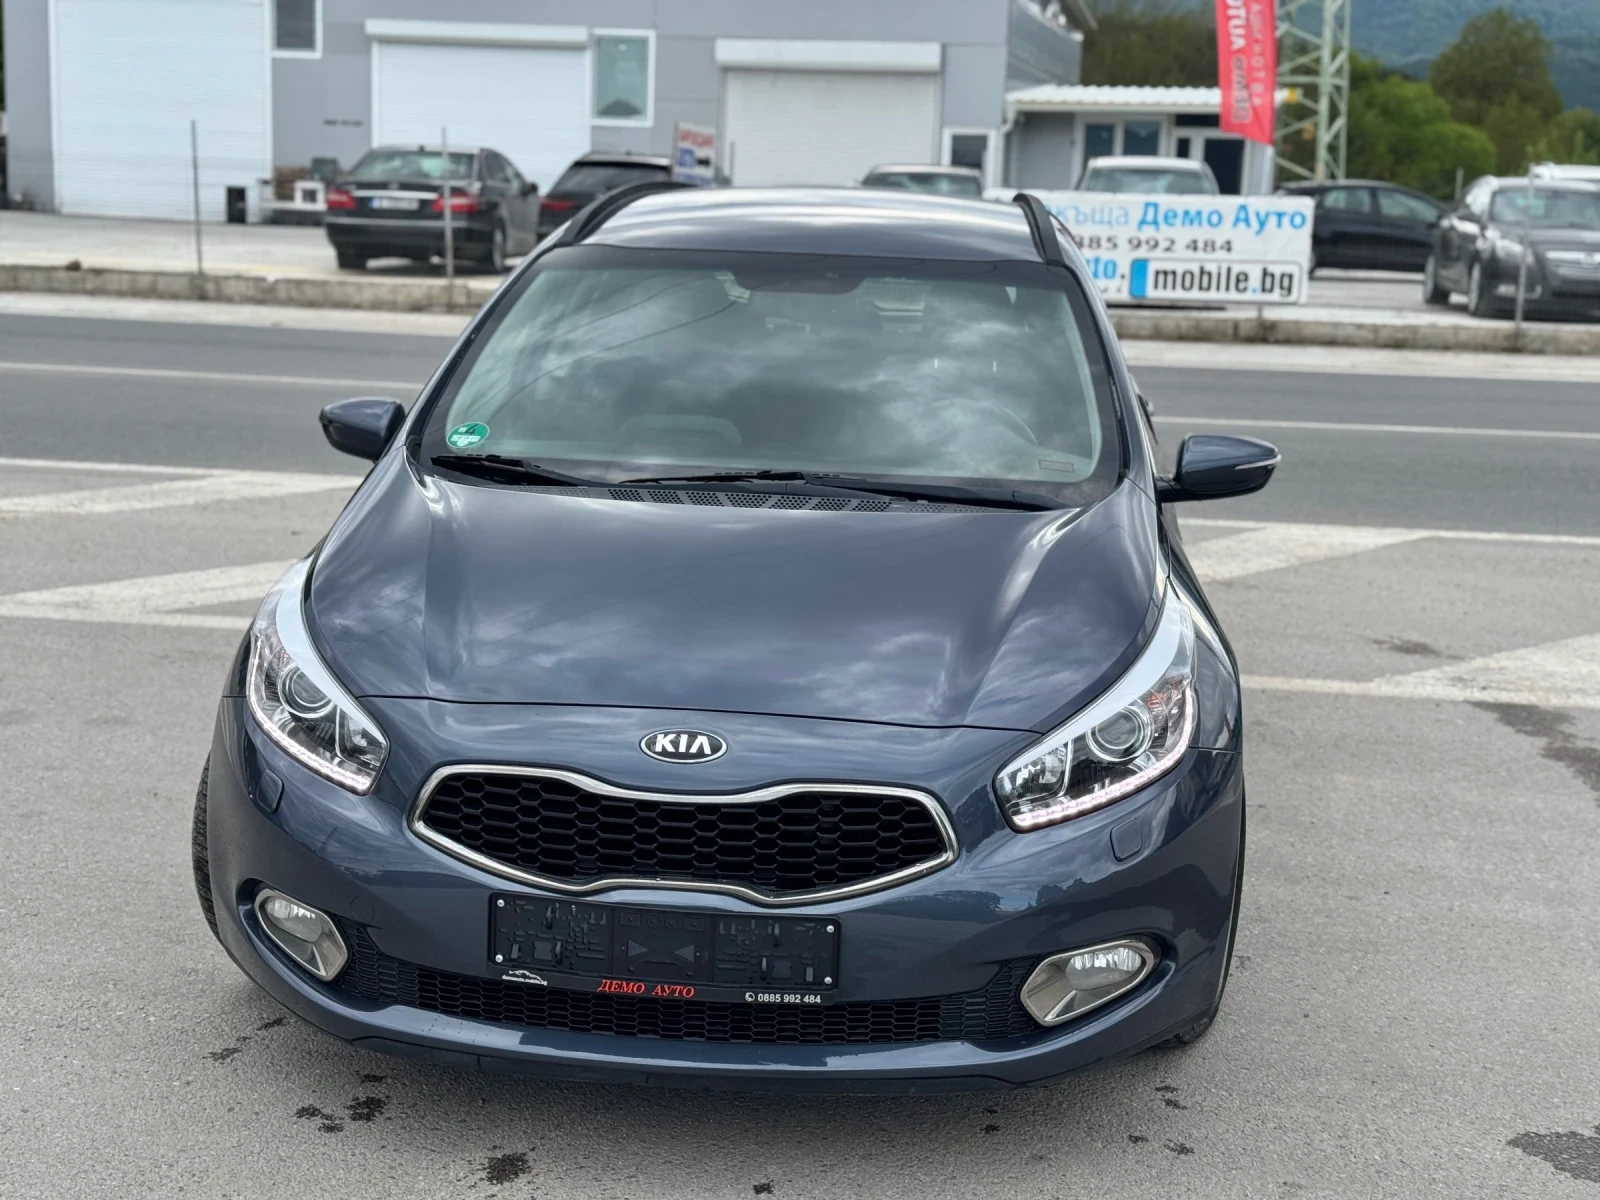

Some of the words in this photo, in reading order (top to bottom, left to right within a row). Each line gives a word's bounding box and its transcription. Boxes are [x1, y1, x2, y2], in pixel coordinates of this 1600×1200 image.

[1047, 204, 1130, 230] къща
[1138, 201, 1223, 231] Демо
[1232, 204, 1307, 236] Ауто
[1128, 236, 1177, 251] 992
[1185, 238, 1235, 253] 484
[1153, 260, 1294, 297] mobile.bg
[654, 733, 712, 755] KIA
[597, 979, 646, 995] ДЕМО
[651, 984, 695, 998] АУТО
[757, 993, 782, 1003] 0885
[783, 994, 801, 1003] 992
[803, 995, 822, 1004] 484
